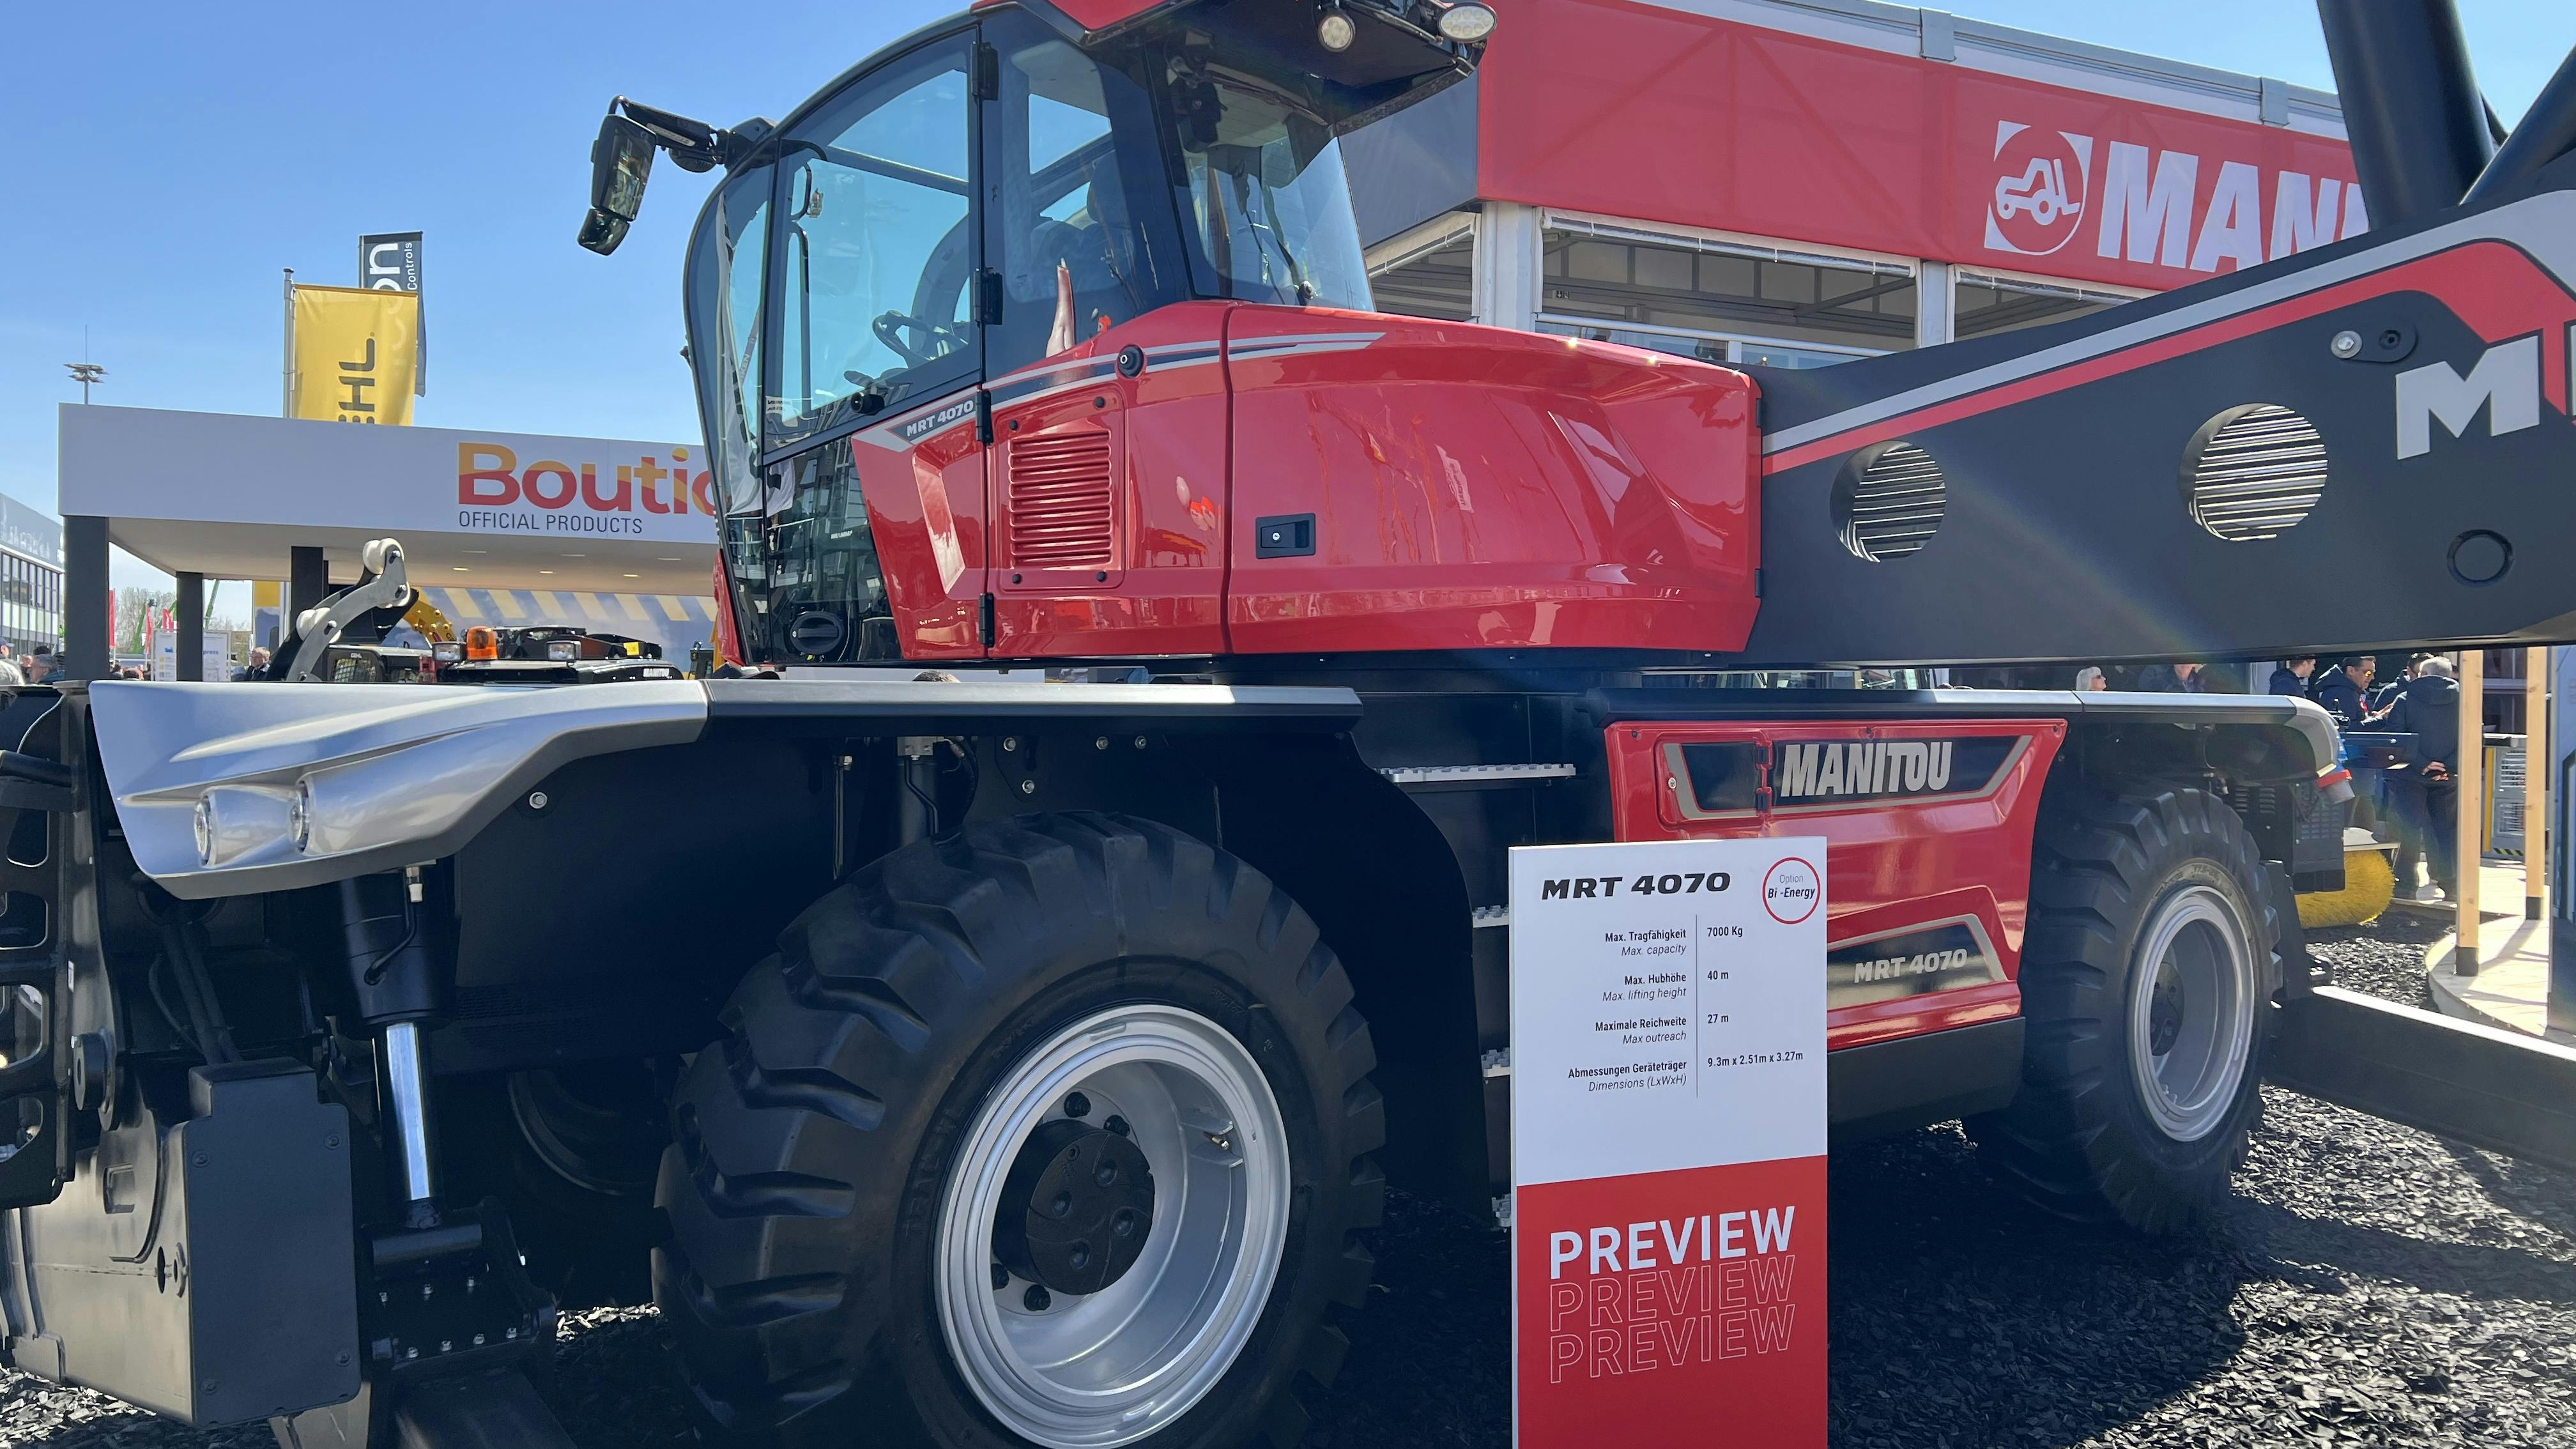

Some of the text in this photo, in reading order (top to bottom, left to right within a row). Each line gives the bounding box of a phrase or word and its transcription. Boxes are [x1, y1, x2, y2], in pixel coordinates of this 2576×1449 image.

[404, 242, 418, 290] Controls
[2396, 325, 2576, 461] M
[907, 400, 974, 436] MRT 4070
[459, 511, 643, 533] OFFICIAL PRODUCTS
[1781, 742, 1952, 797] MANITOU
[1542, 872, 1730, 900] MRT 4070
[1779, 874, 1804, 885] Option
[1605, 928, 1687, 942] Max. Tragfähigkeit
[1707, 926, 1743, 938] 7000 Kg
[1621, 944, 1687, 956] Max. capacity
[1707, 970, 1729, 980] 40 m
[1854, 949, 1967, 983] MRT 4070
[1625, 972, 1687, 985] Max. Hubhöhe
[1602, 986, 1687, 1002] Max. lifting height
[1595, 1016, 1687, 1032] Maximale Reichweite
[1707, 1014, 1729, 1023] 27 m
[1623, 1030, 1687, 1045] Max outreach
[1708, 1057, 1729, 1067] 9.3m
[1732, 1057, 1737, 1066] x
[1739, 1054, 1767, 1065] 2.51m
[1776, 1051, 1804, 1062] 3.27m
[1568, 1060, 1687, 1079] Abmessungen Geräteträger
[1588, 1073, 1687, 1092] Dimensions (LxWxH)
[1551, 1206, 1795, 1280] PREVIEW
[1550, 1254, 1795, 1332] PREVIEW
[1550, 1304, 1795, 1383] PREVIEW
